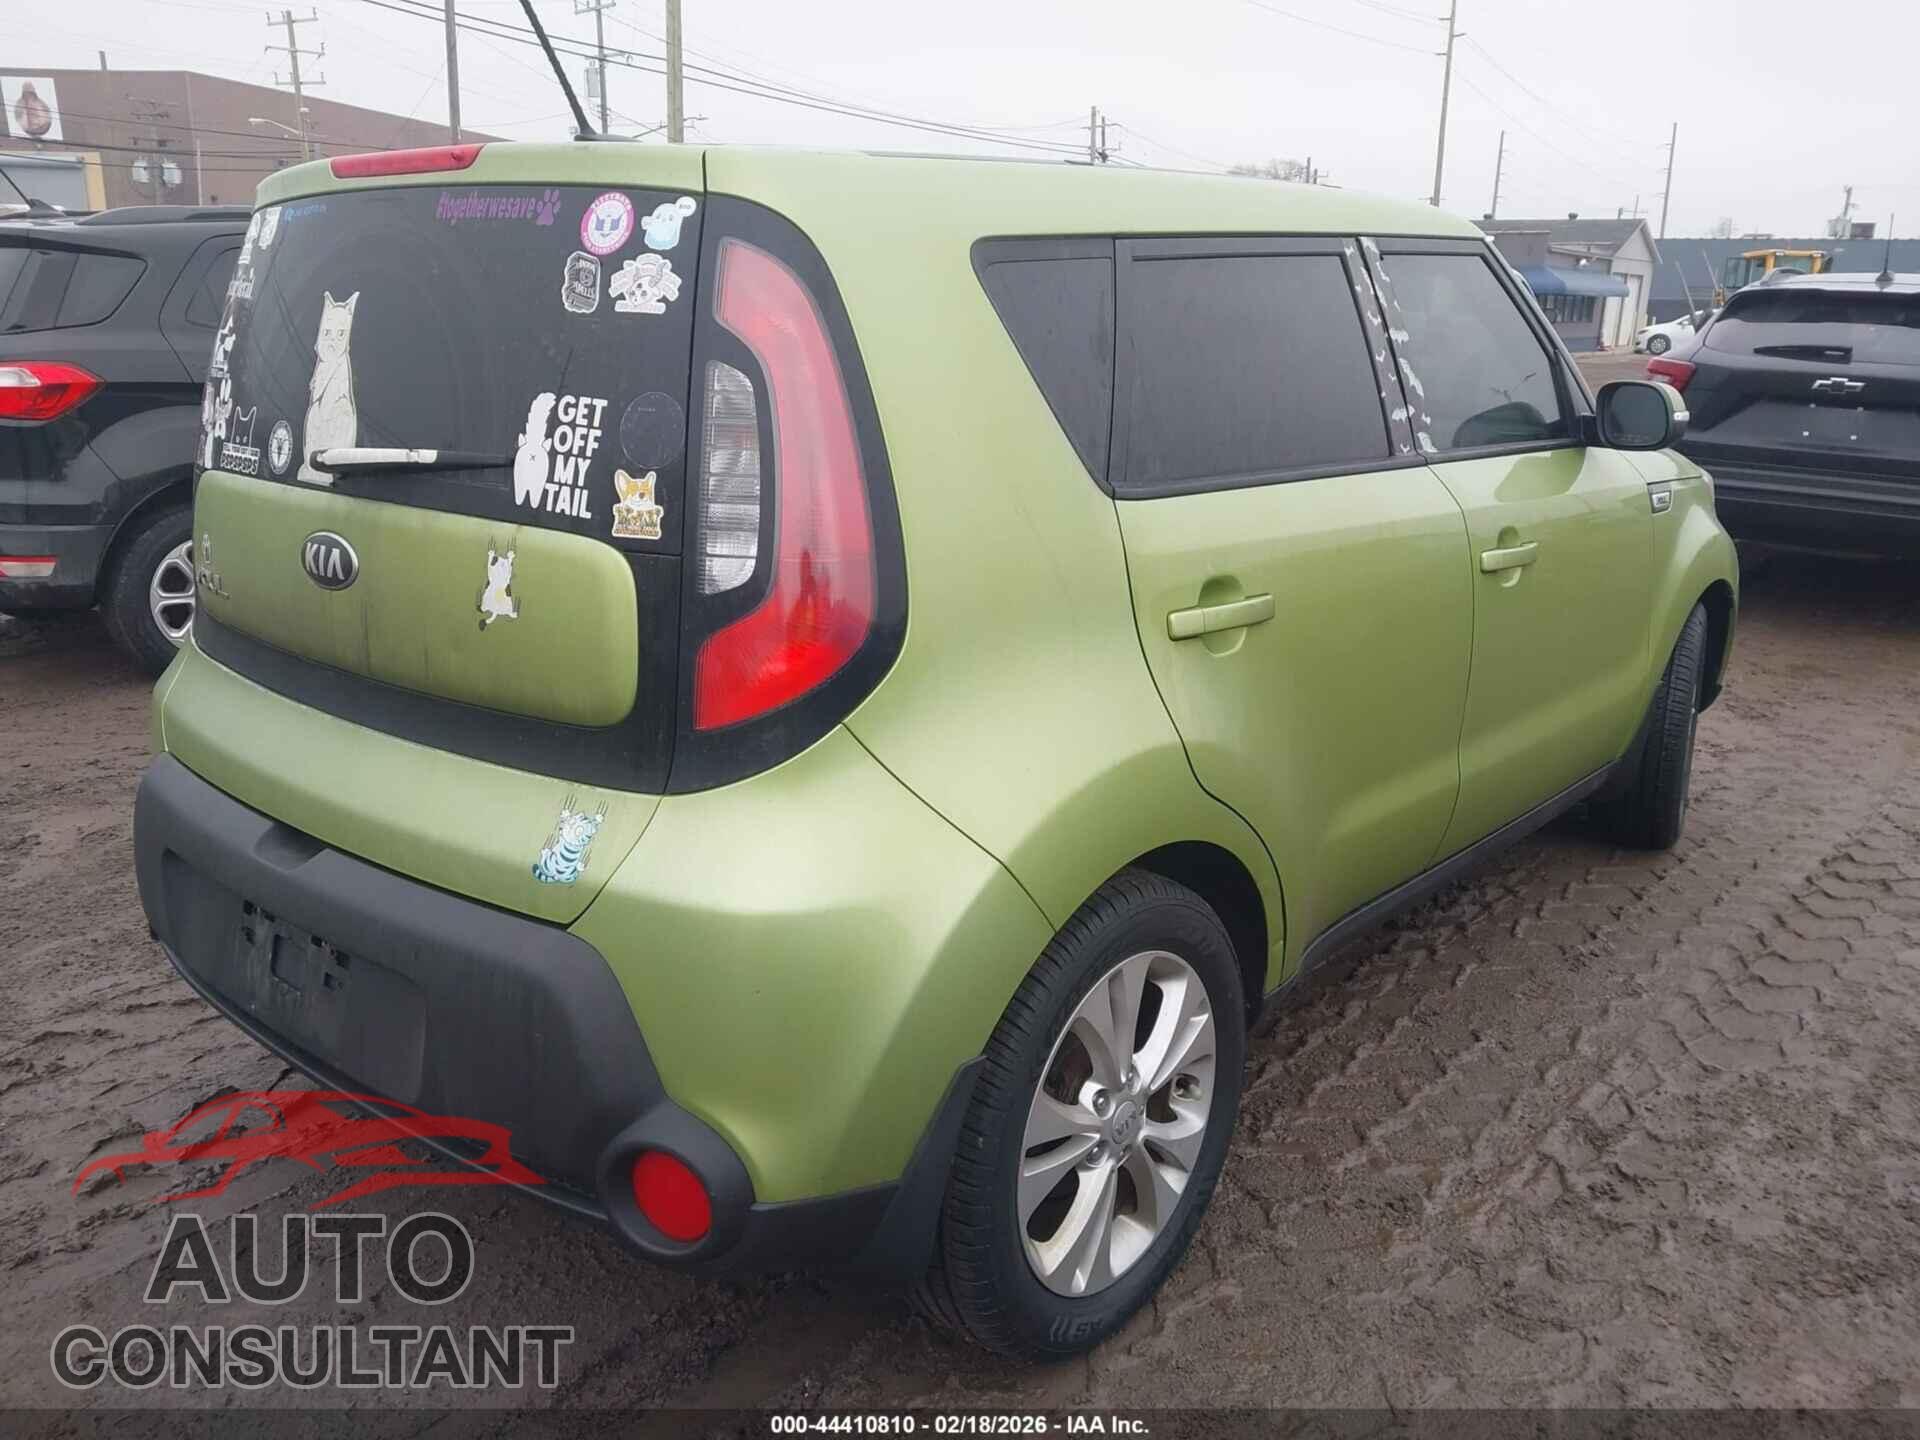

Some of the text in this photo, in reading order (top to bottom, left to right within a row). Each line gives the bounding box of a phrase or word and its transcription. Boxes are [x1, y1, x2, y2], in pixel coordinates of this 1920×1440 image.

[557, 394, 608, 427] GET
[553, 424, 602, 457] OFF
[553, 454, 591, 486] MY
[544, 482, 592, 519] TAIL
[304, 541, 345, 581] KIA
